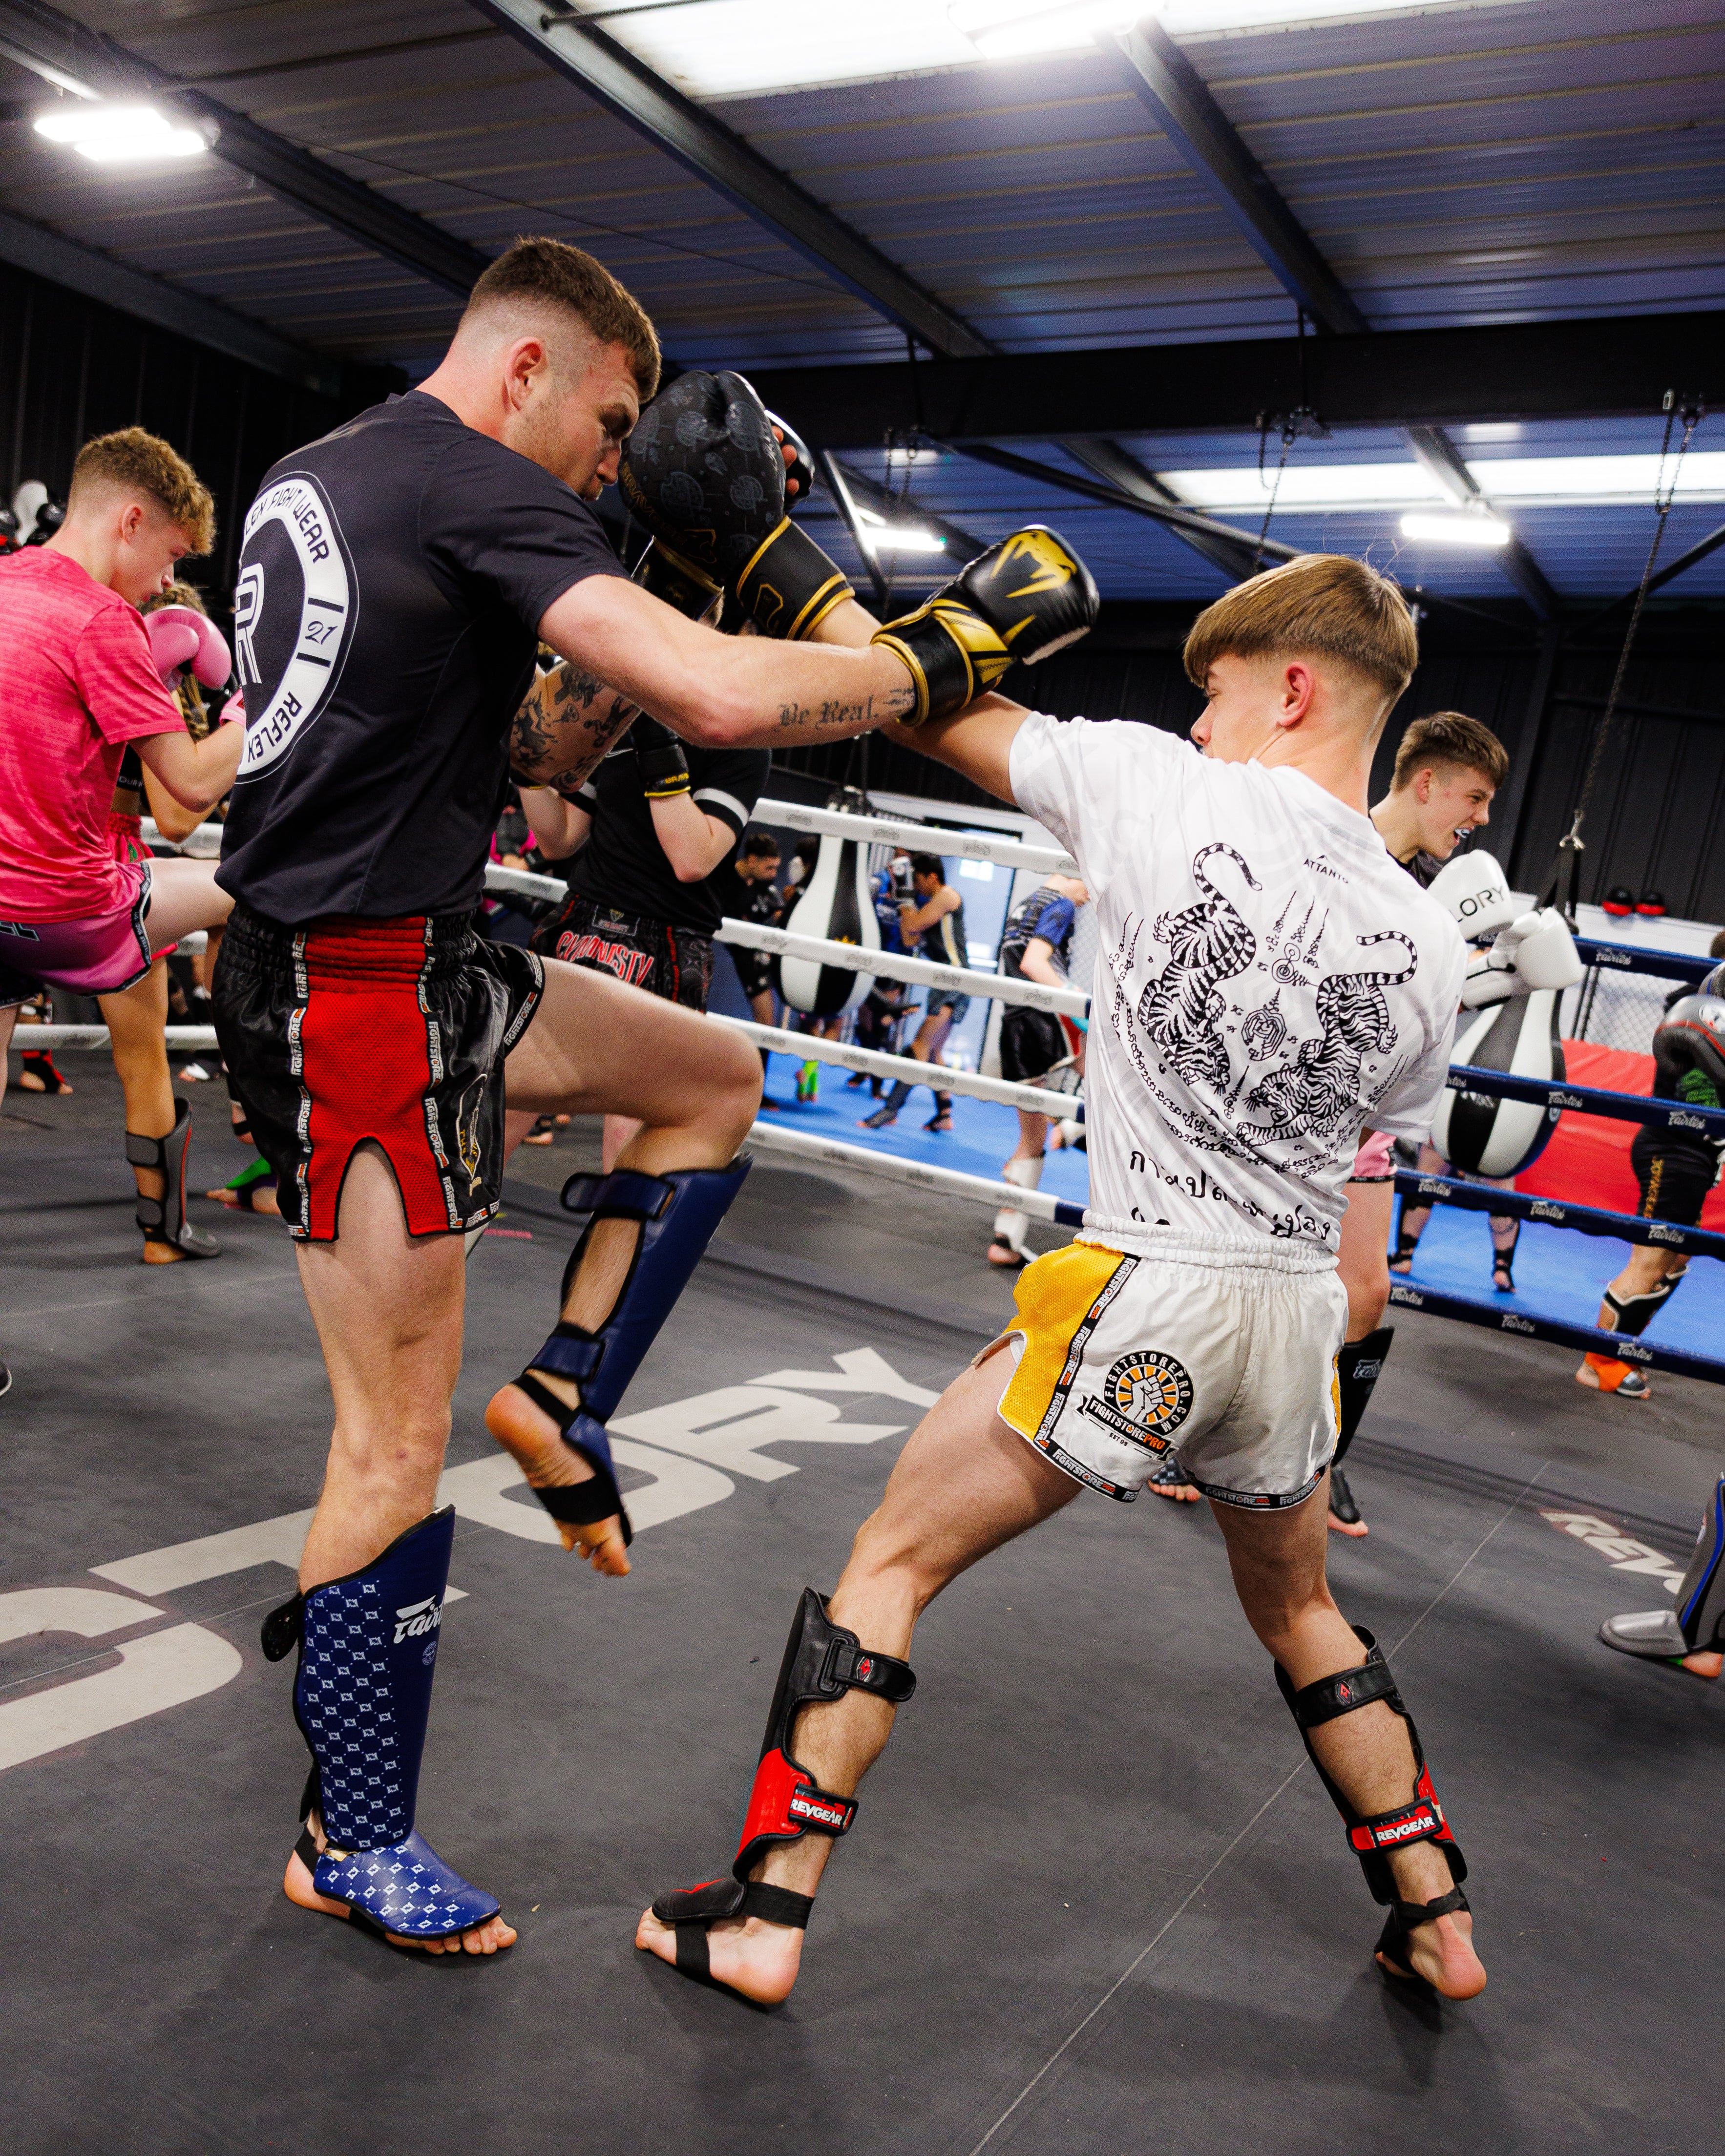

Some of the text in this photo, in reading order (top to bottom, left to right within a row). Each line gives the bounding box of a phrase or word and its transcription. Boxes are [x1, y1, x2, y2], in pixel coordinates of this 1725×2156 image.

[305, 620, 338, 646] 21
[248, 691, 303, 763] REFLEX
[1449, 886, 1505, 922] LORY
[1109, 1432, 1120, 1443] EST
[790, 1798, 843, 1825] REVGEAR
[1376, 1817, 1435, 1841] REVGEAR
